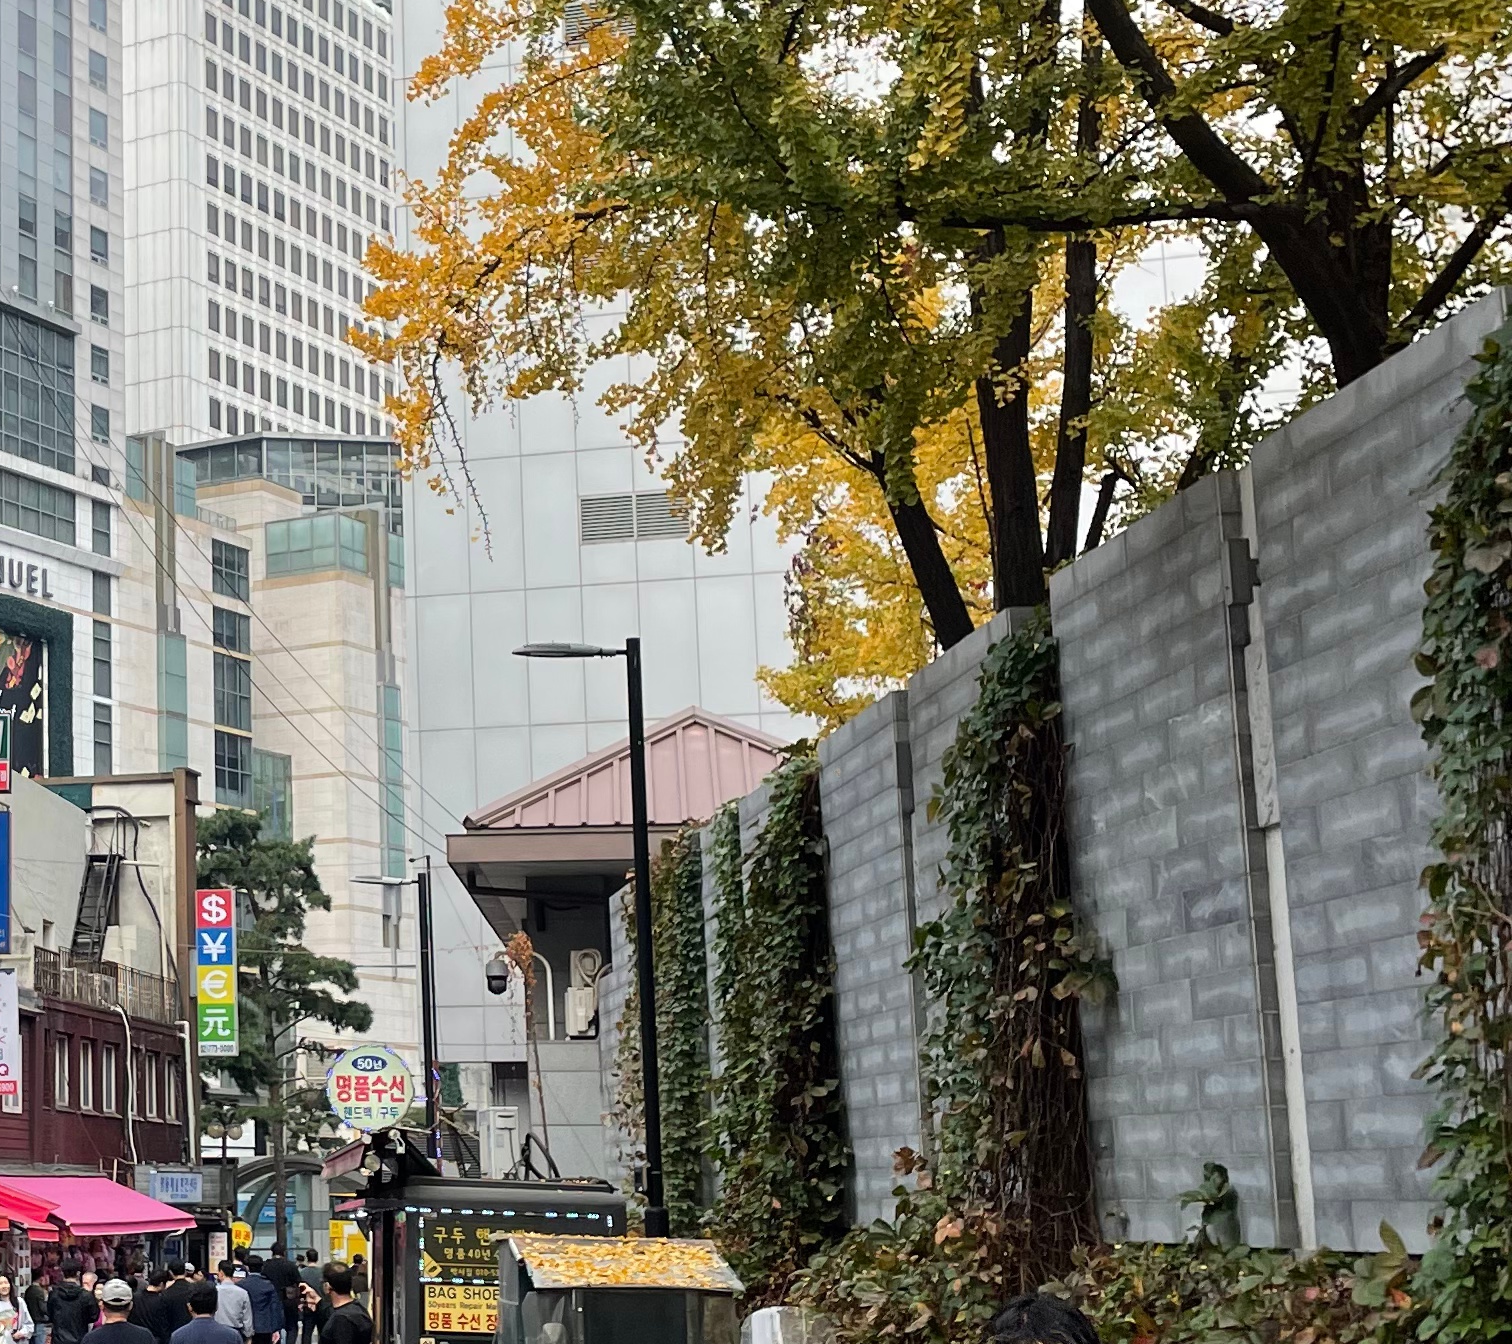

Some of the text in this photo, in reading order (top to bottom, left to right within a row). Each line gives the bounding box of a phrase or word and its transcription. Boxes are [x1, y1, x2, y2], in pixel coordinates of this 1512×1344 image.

[201, 893, 227, 925] $
[201, 1008, 231, 1037] 元
[357, 1058, 382, 1069] 50년
[336, 1075, 405, 1103] 명품수선
[433, 1227, 466, 1244] 구두
[428, 1287, 457, 1299] BAG
[429, 1312, 452, 1329] 명품
[457, 1313, 481, 1331] 수선
